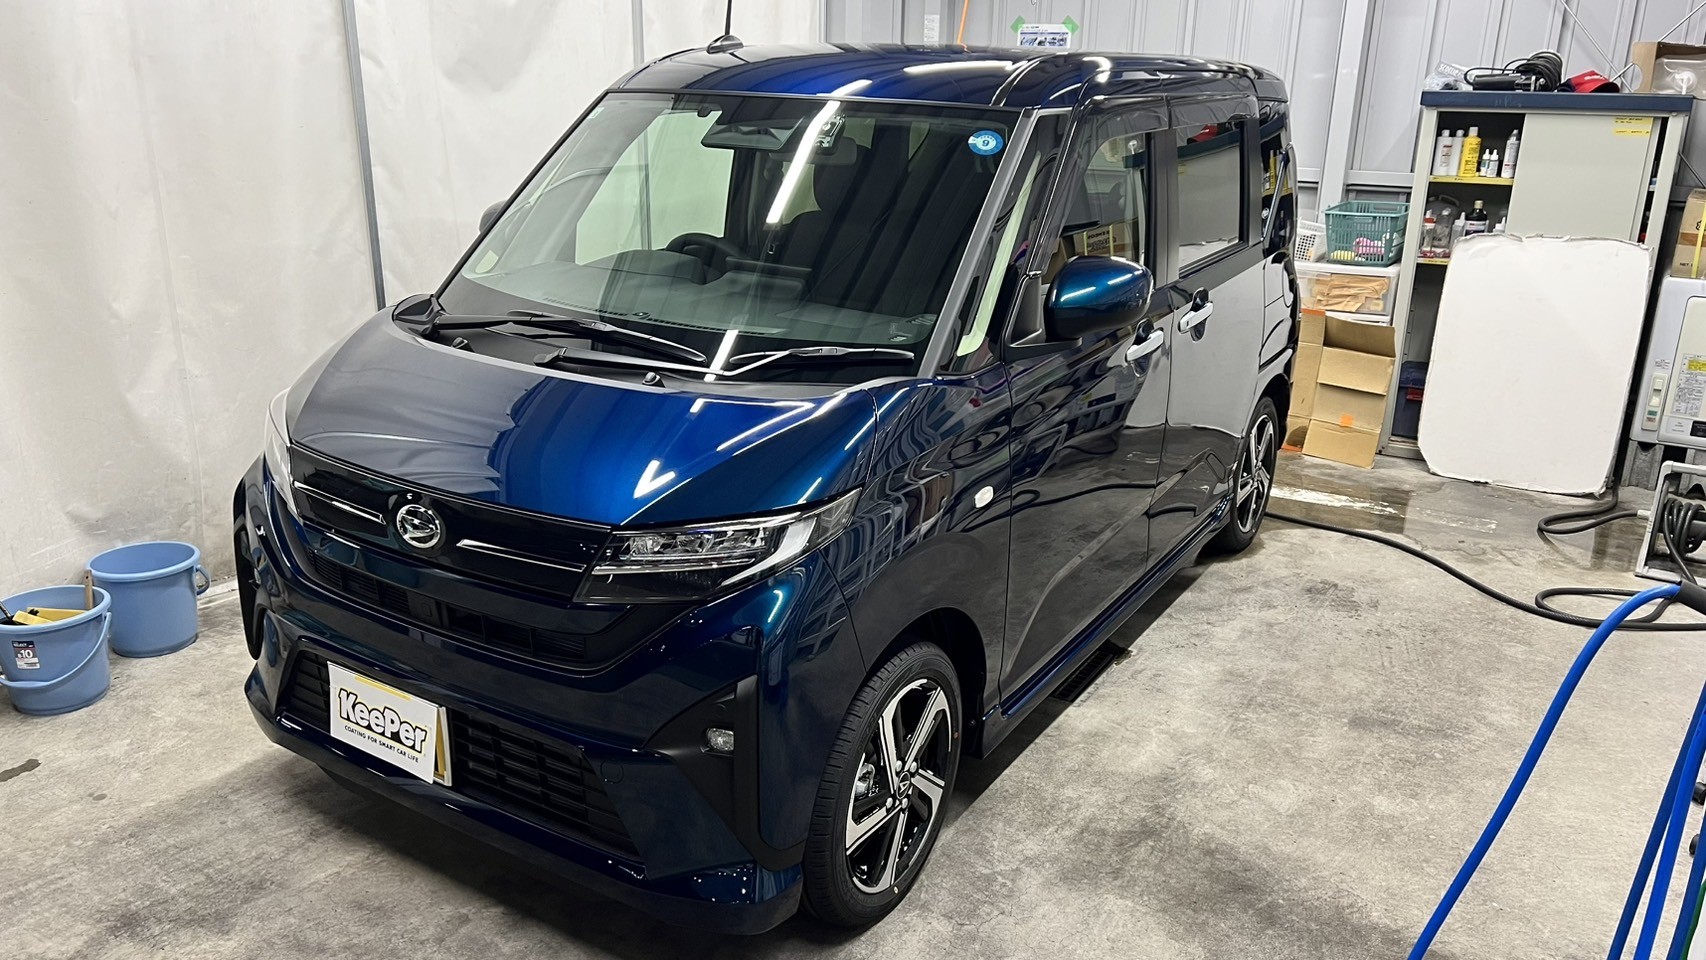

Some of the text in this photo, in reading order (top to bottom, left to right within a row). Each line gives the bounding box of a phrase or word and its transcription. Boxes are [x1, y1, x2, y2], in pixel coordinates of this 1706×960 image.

[982, 139, 990, 147] 9
[338, 687, 428, 754] KeePer
[344, 725, 419, 763] COATING FOR SMART CAR LIFE
